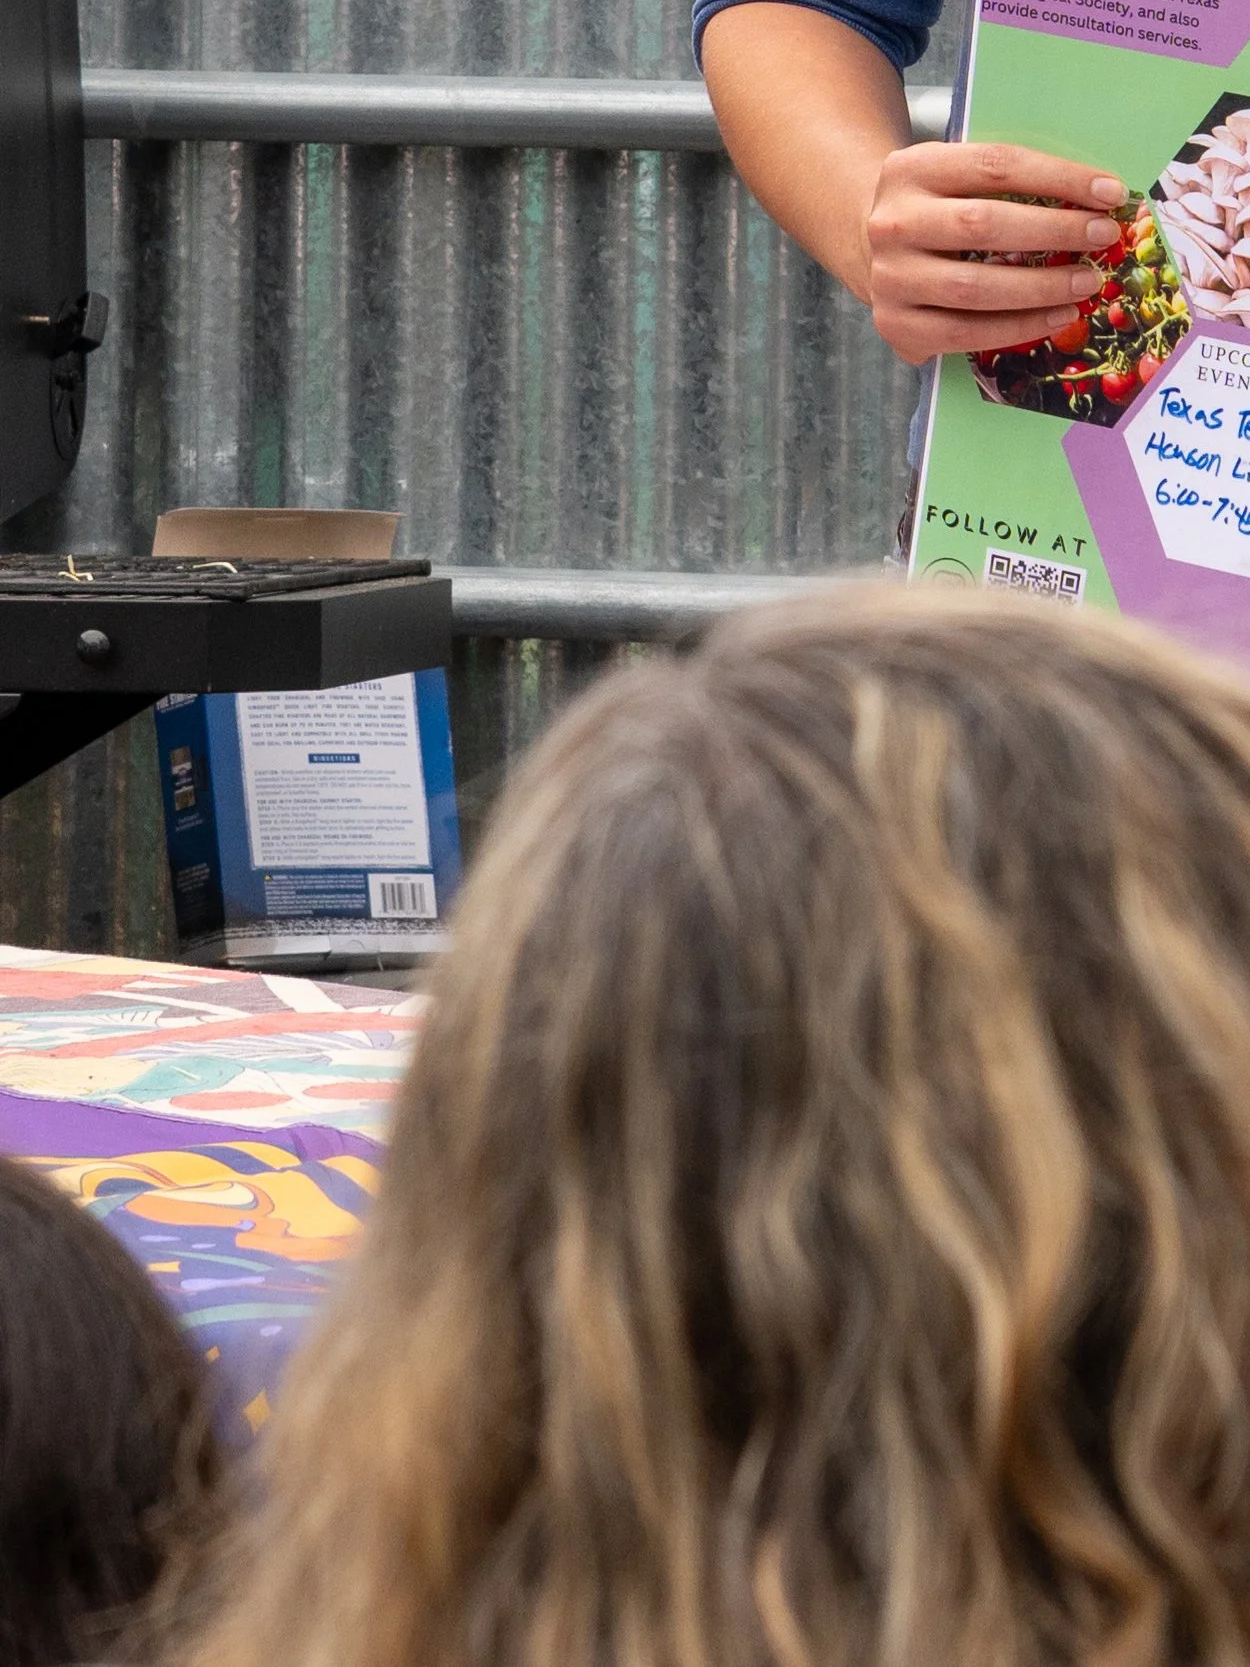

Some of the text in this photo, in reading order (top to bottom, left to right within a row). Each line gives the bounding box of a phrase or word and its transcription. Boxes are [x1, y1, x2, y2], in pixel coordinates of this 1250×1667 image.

[981, 0, 1202, 51] provide consultation services.
[1138, 7, 1166, 21] and
[1169, 11, 1199, 28] also
[1159, 387, 1224, 430] Texas
[926, 504, 1087, 557] FOLLOW AT
